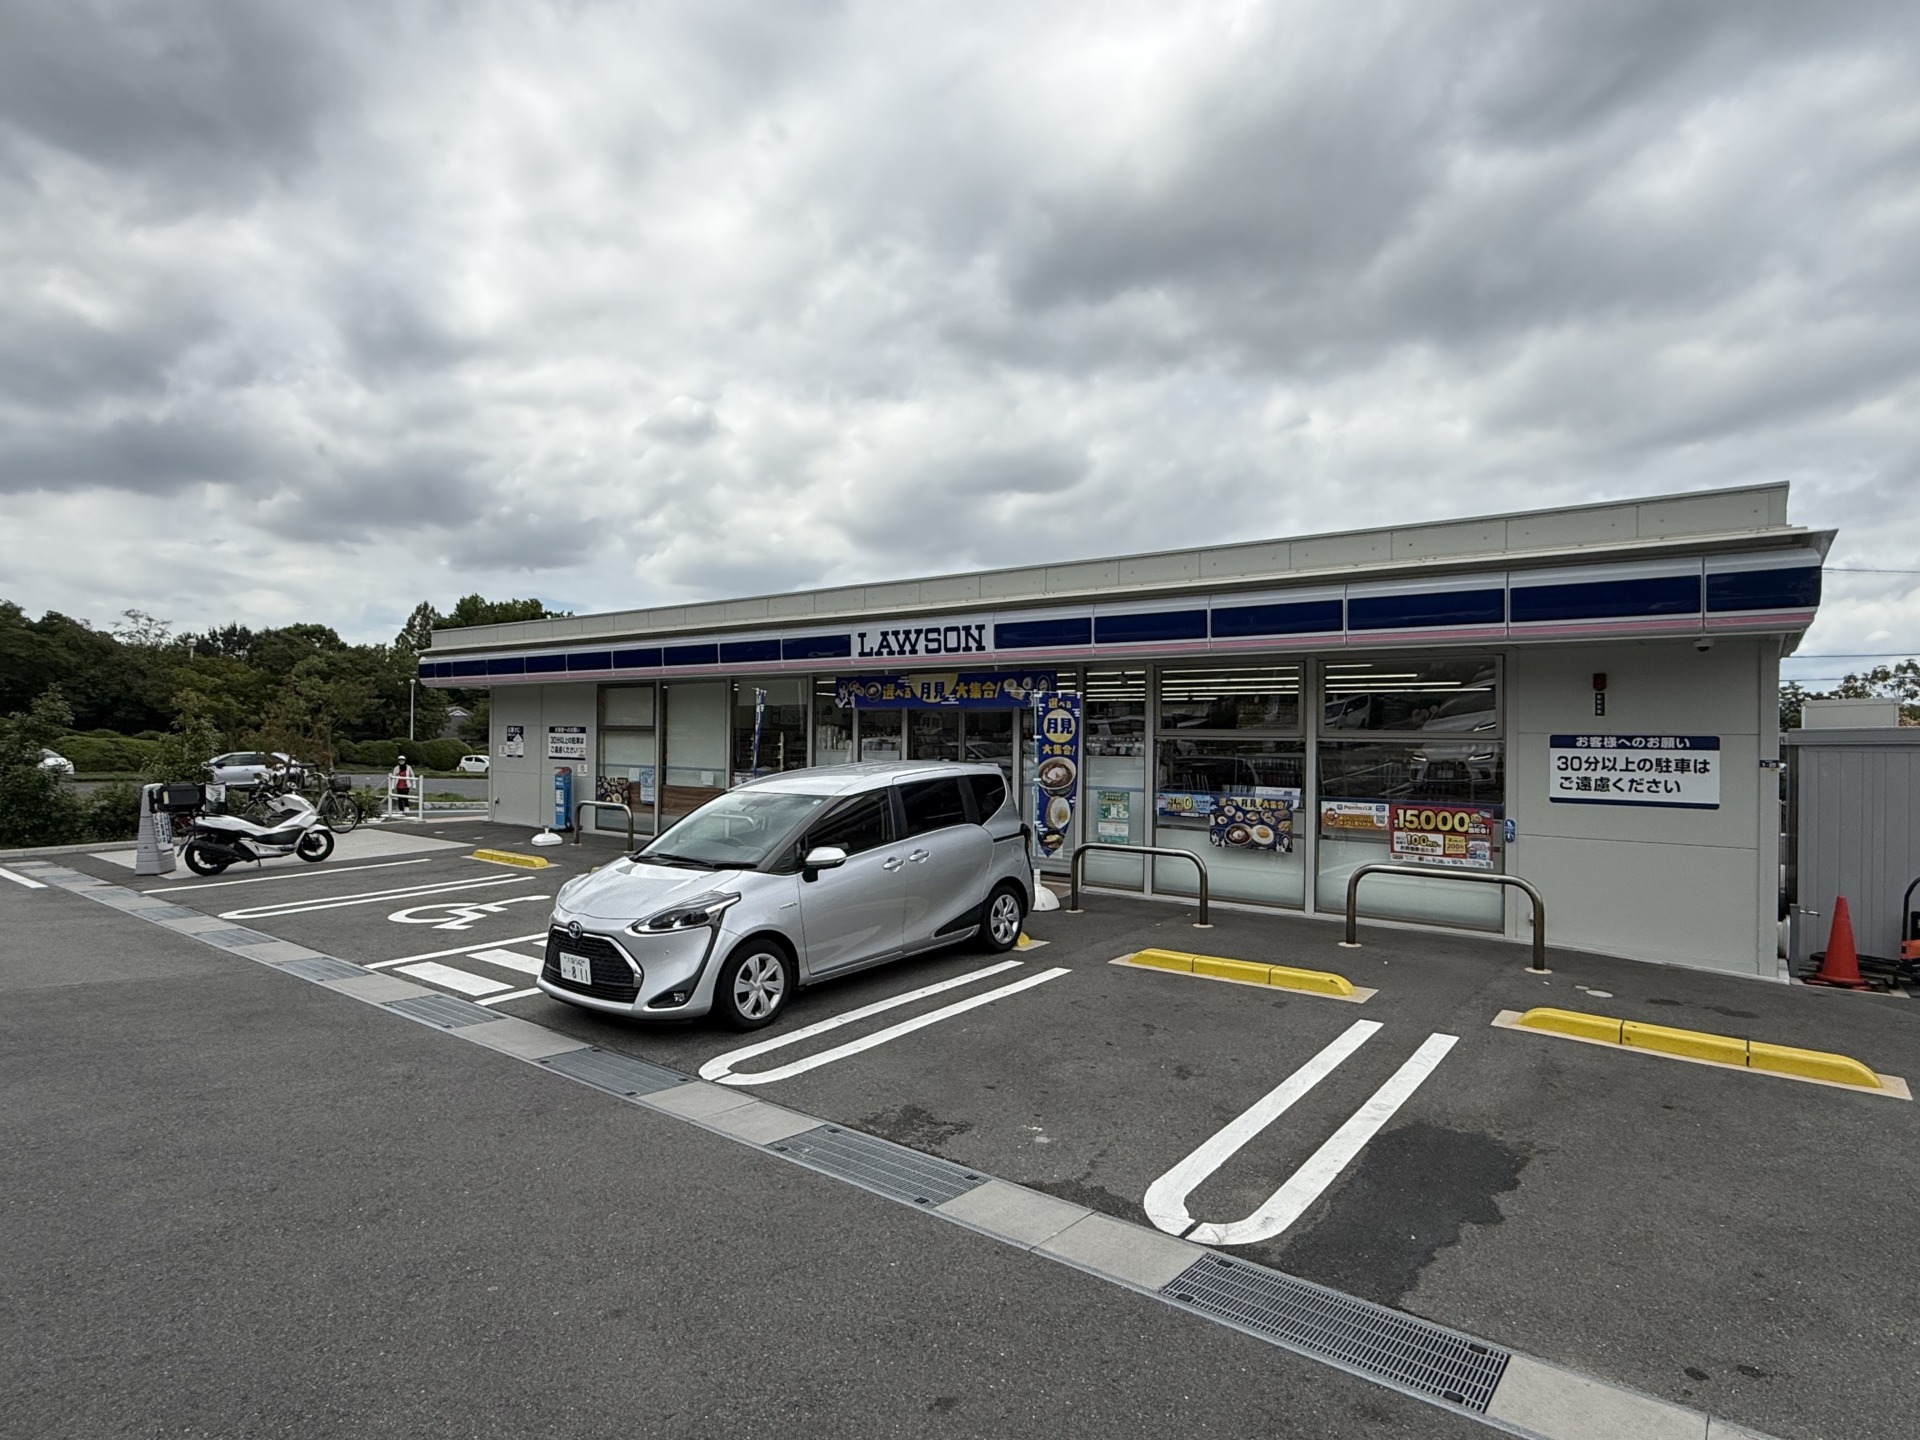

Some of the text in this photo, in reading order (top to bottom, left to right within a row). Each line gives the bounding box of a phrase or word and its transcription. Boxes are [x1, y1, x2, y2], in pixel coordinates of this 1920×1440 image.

[858, 624, 985, 657] LAWSON
[921, 681, 946, 700] 月見
[1046, 717, 1073, 734] 月見
[1576, 736, 1691, 749] お客様へのお願い
[1556, 755, 1711, 775] 30分以上の駐車は
[1559, 776, 1681, 794] ご遠慮ください
[1397, 809, 1470, 832] 15,000
